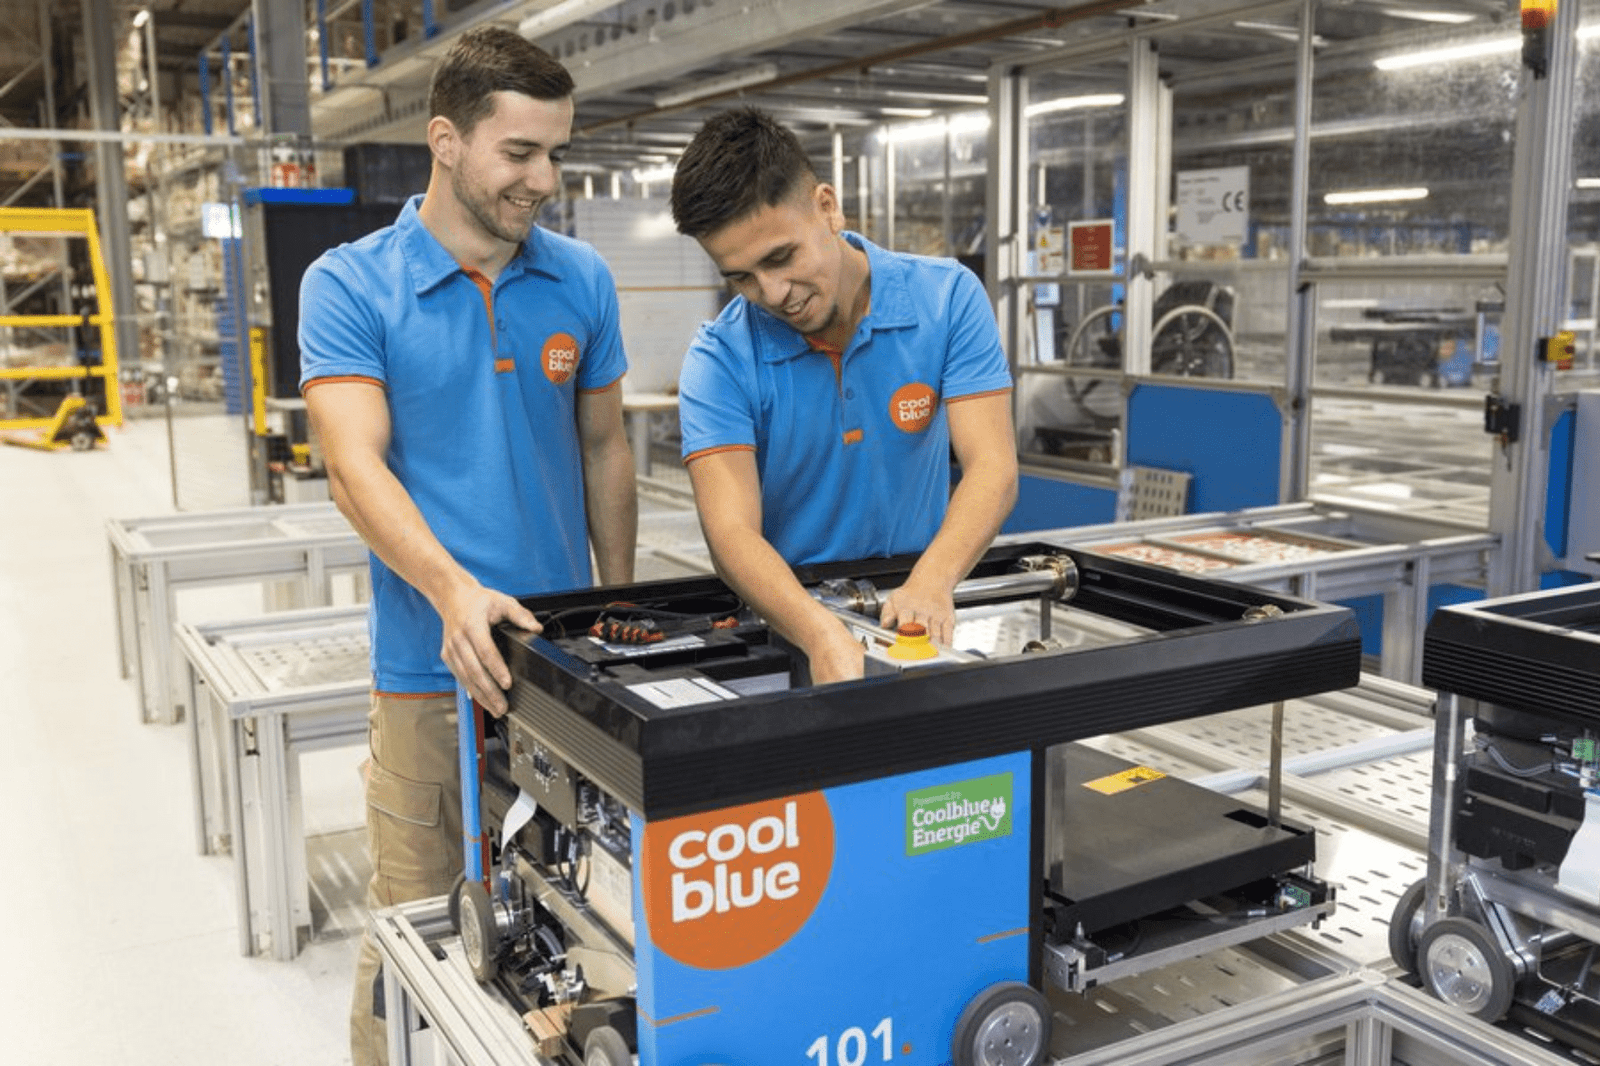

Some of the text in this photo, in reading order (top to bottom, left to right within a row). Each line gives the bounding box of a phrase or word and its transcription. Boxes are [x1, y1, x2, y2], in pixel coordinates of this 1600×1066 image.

[548, 348, 575, 361] cool
[899, 395, 930, 410] cool
[899, 408, 930, 422] blue
[912, 799, 990, 827] Coolblue
[668, 800, 800, 869] cool
[912, 817, 981, 848] Energie
[671, 859, 801, 923] blue
